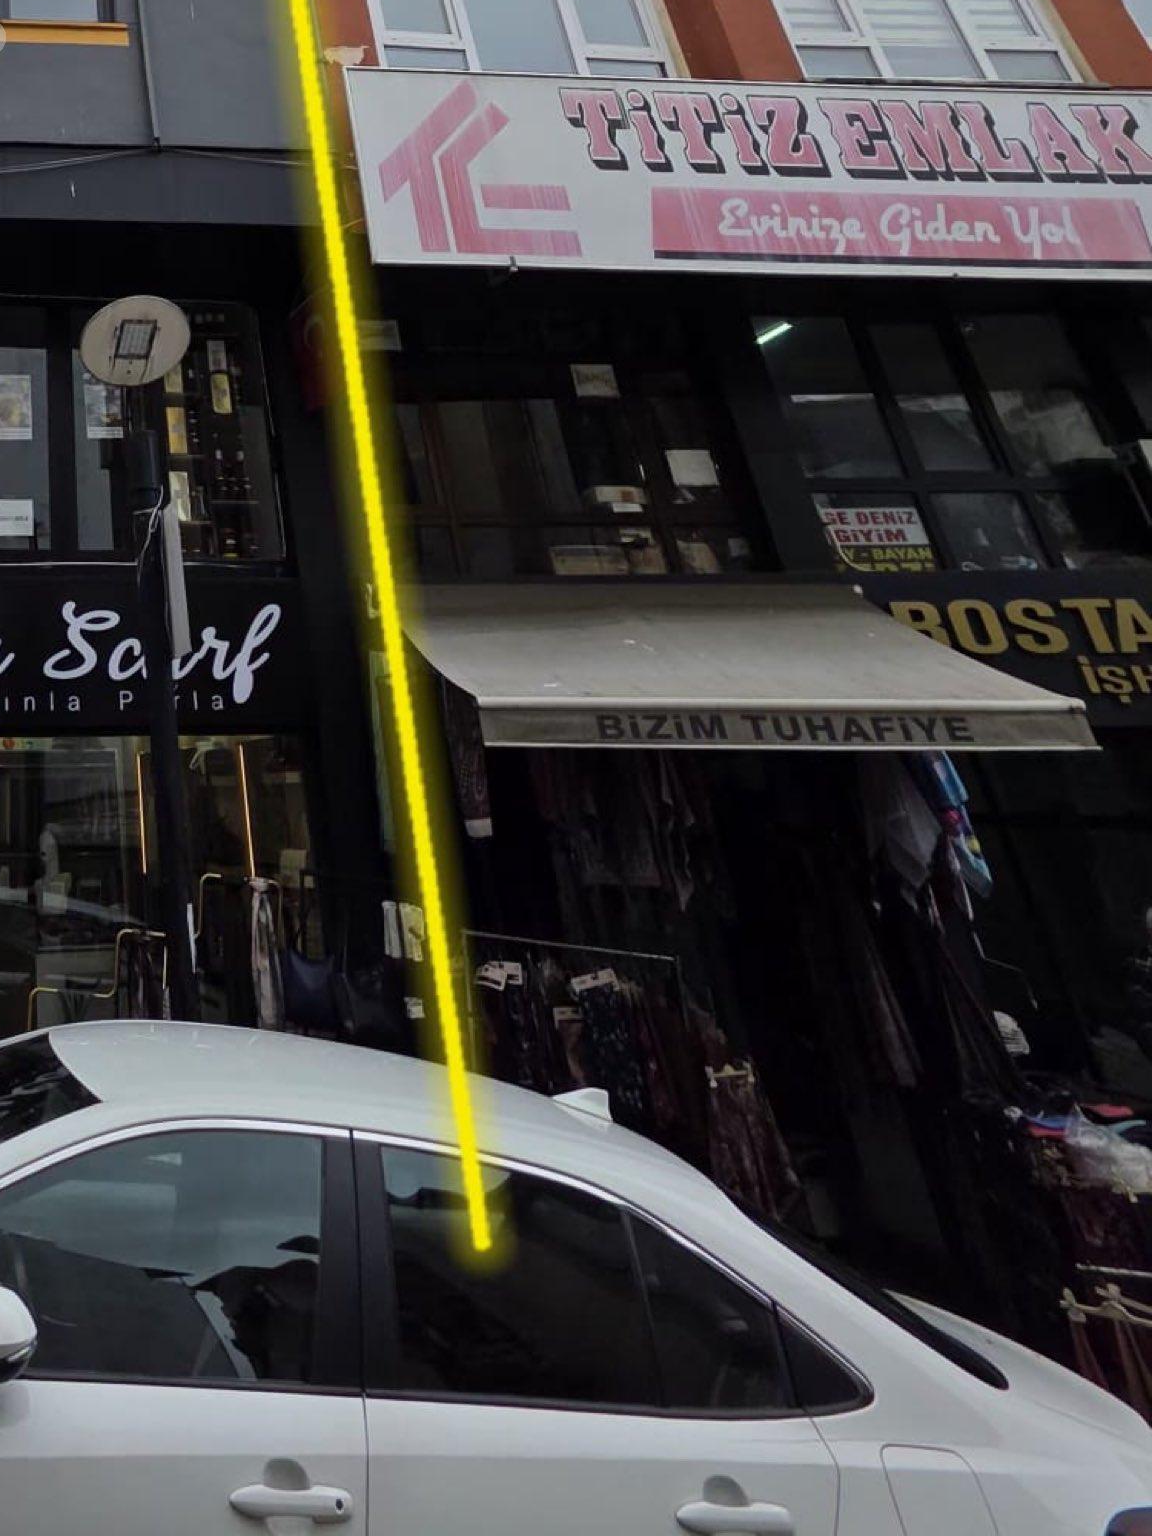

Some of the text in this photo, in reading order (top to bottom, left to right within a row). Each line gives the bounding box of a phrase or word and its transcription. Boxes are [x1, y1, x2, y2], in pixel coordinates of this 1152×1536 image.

[817, 97, 1152, 184] EMLAK
[719, 198, 1081, 259] Evinize Giden Yol
[43, 601, 281, 704] Scrf
[889, 598, 1152, 654] BOSTA
[119, 690, 224, 712] Prla
